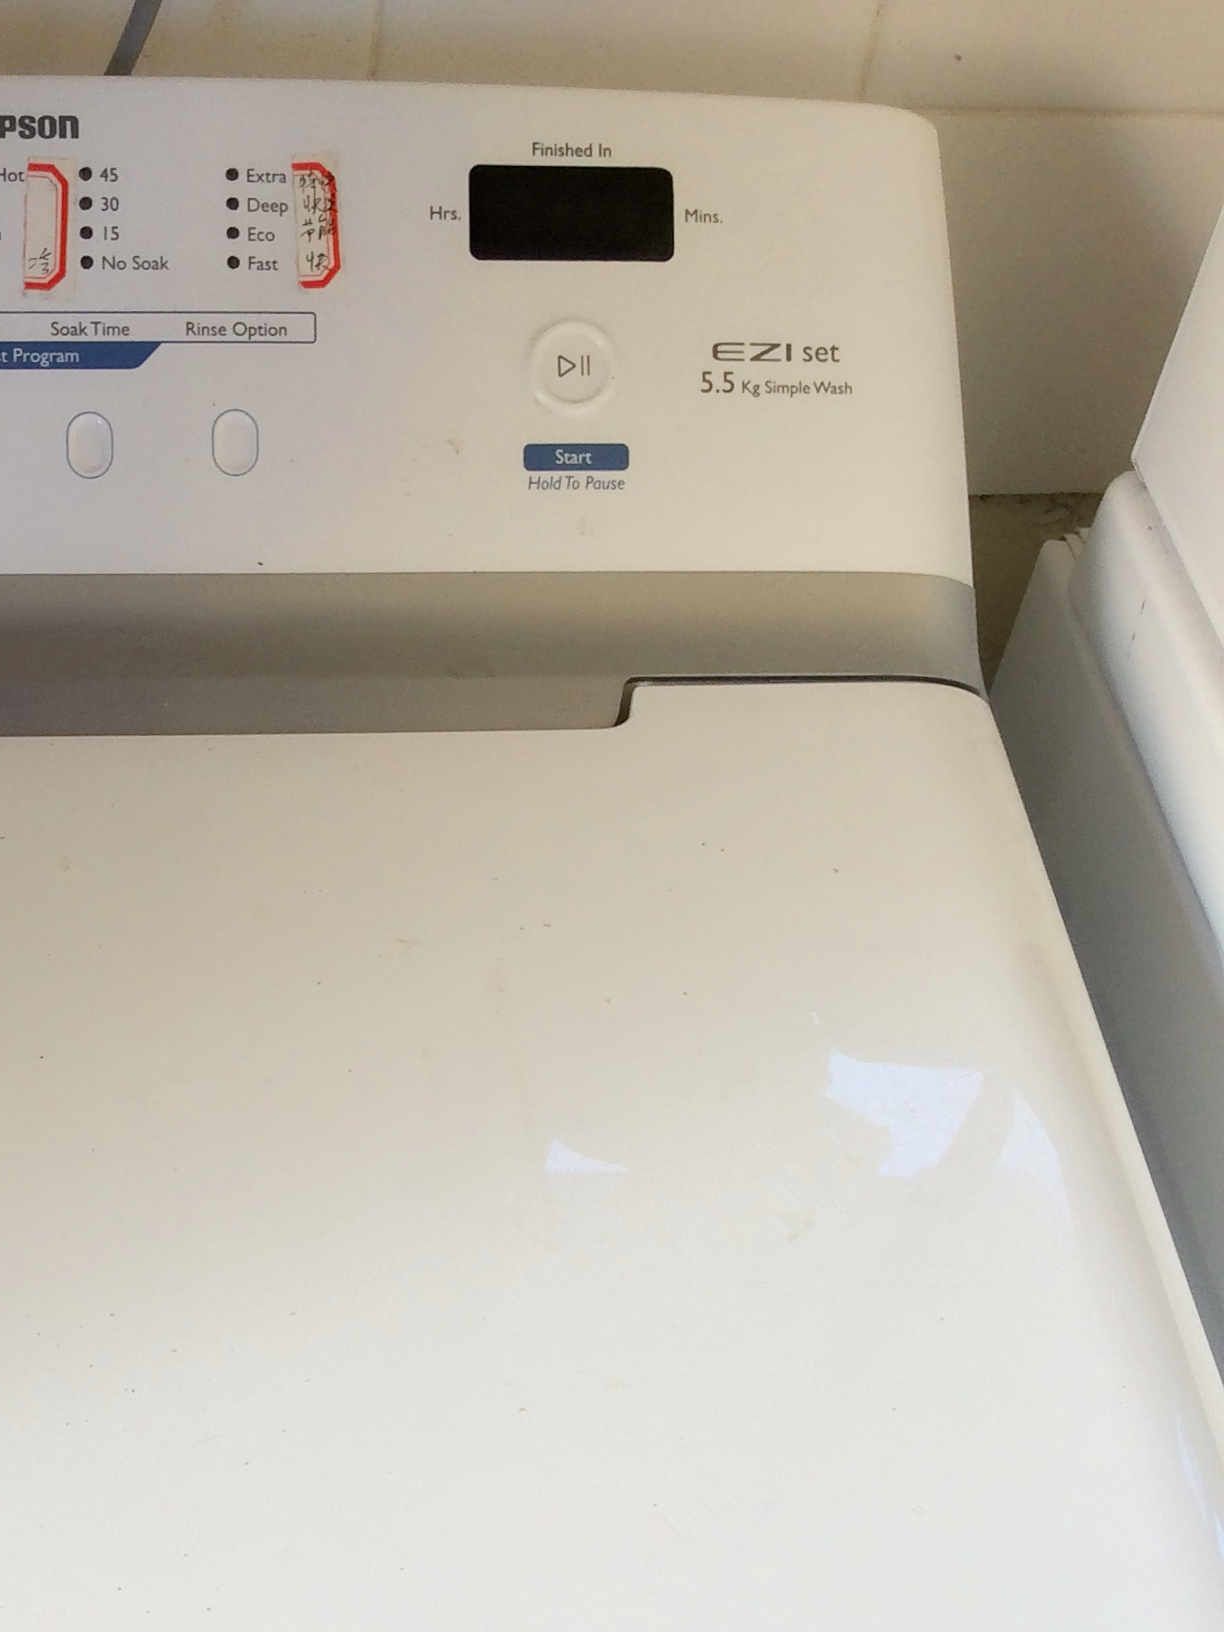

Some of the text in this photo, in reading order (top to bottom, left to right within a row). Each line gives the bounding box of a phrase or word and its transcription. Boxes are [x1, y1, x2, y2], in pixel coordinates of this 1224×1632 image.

[531, 141, 612, 158] Finished In
[99, 167, 119, 183] 45
[246, 168, 287, 184] Extra
[100, 196, 120, 212] 30
[247, 197, 289, 217] Deep
[429, 205, 462, 221] Hrs.
[684, 208, 724, 224] Mins.
[103, 225, 120, 241] 15
[247, 226, 276, 242] Eco
[101, 255, 169, 271] No Soak
[247, 255, 279, 272] Fast
[50, 320, 131, 337] Soak Time
[185, 321, 288, 341] Rinse Option
[13, 347, 80, 368] Program
[711, 341, 840, 363] EZI set
[700, 370, 853, 399] 5.5 Kg Simple Wash
[555, 448, 593, 465] Start
[527, 474, 626, 491] Hold To Pause
